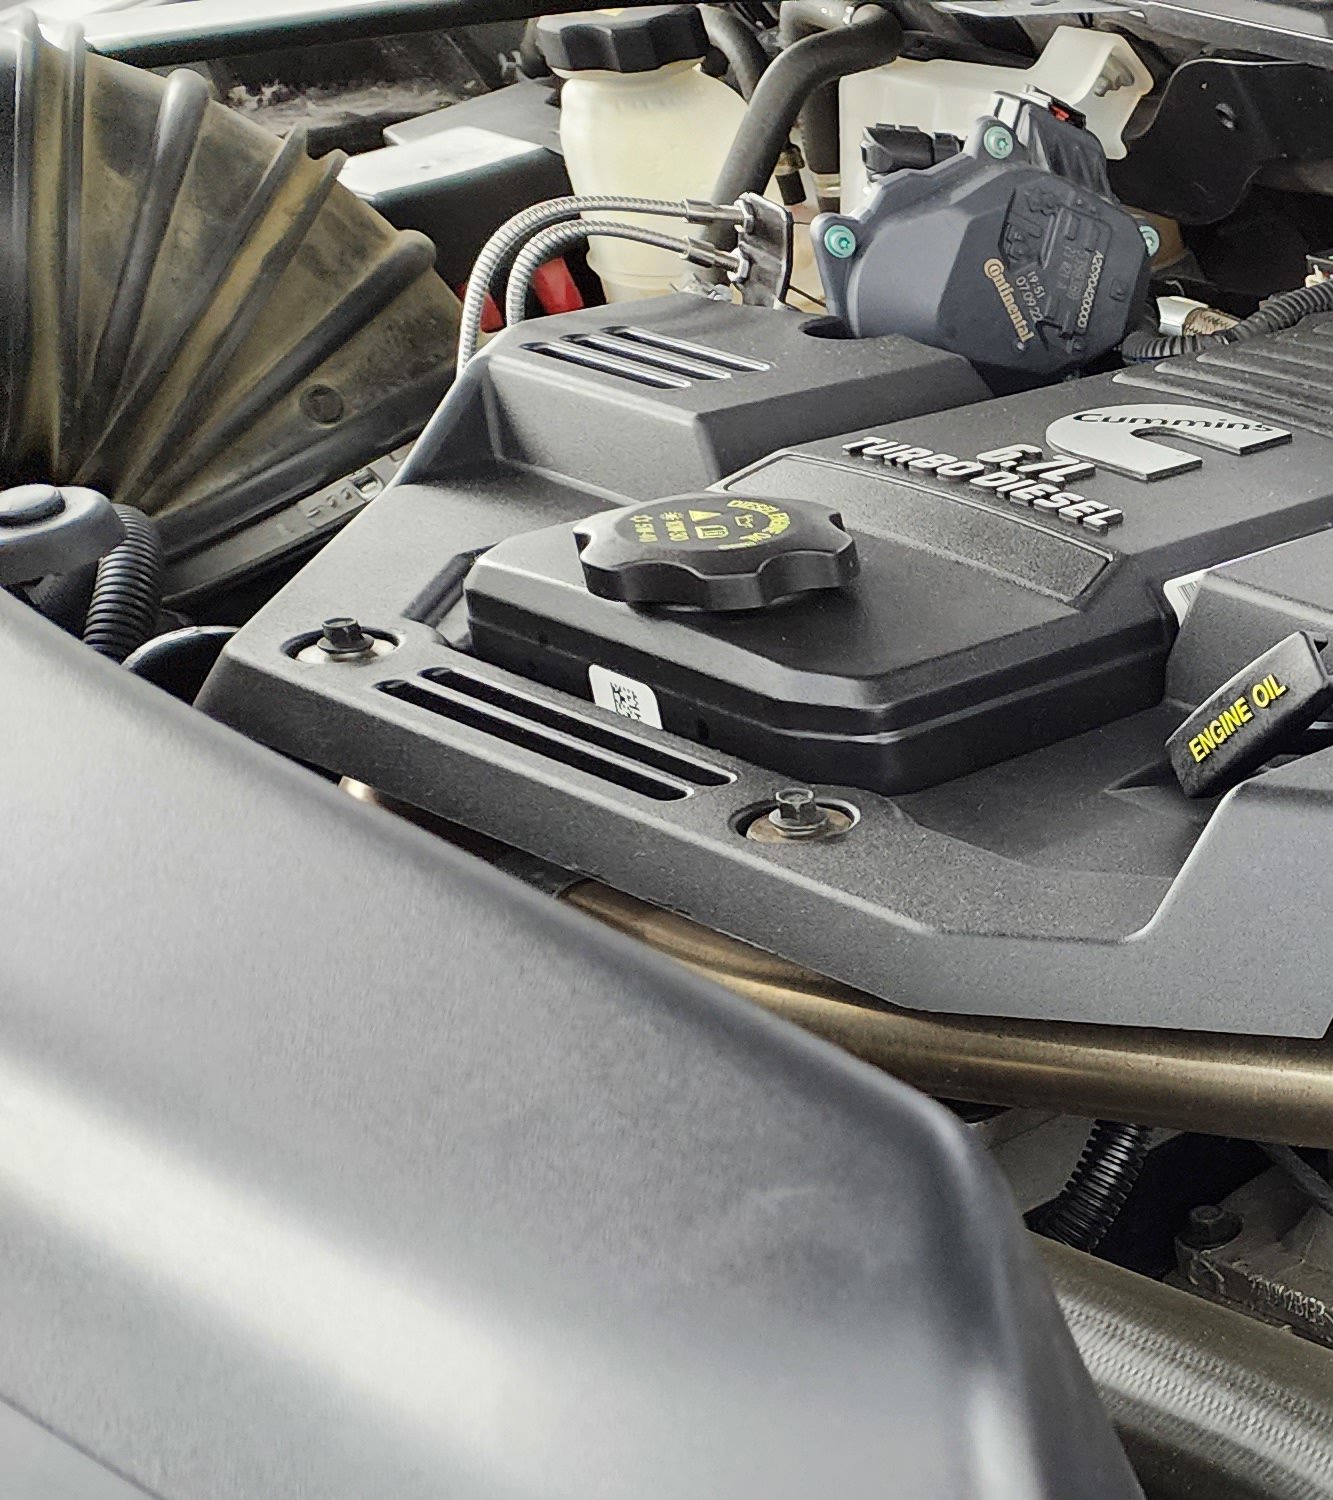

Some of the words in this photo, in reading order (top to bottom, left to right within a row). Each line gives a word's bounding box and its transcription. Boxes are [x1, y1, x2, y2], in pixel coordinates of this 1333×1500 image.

[984, 258, 1034, 342] Continental
[1073, 412, 1277, 432] Cummins
[841, 436, 985, 480] TURBO
[969, 470, 1124, 534] DIESEL
[976, 443, 1096, 487] 6.7L
[1188, 696, 1254, 764] ENGINE
[1252, 673, 1288, 709] OIL
